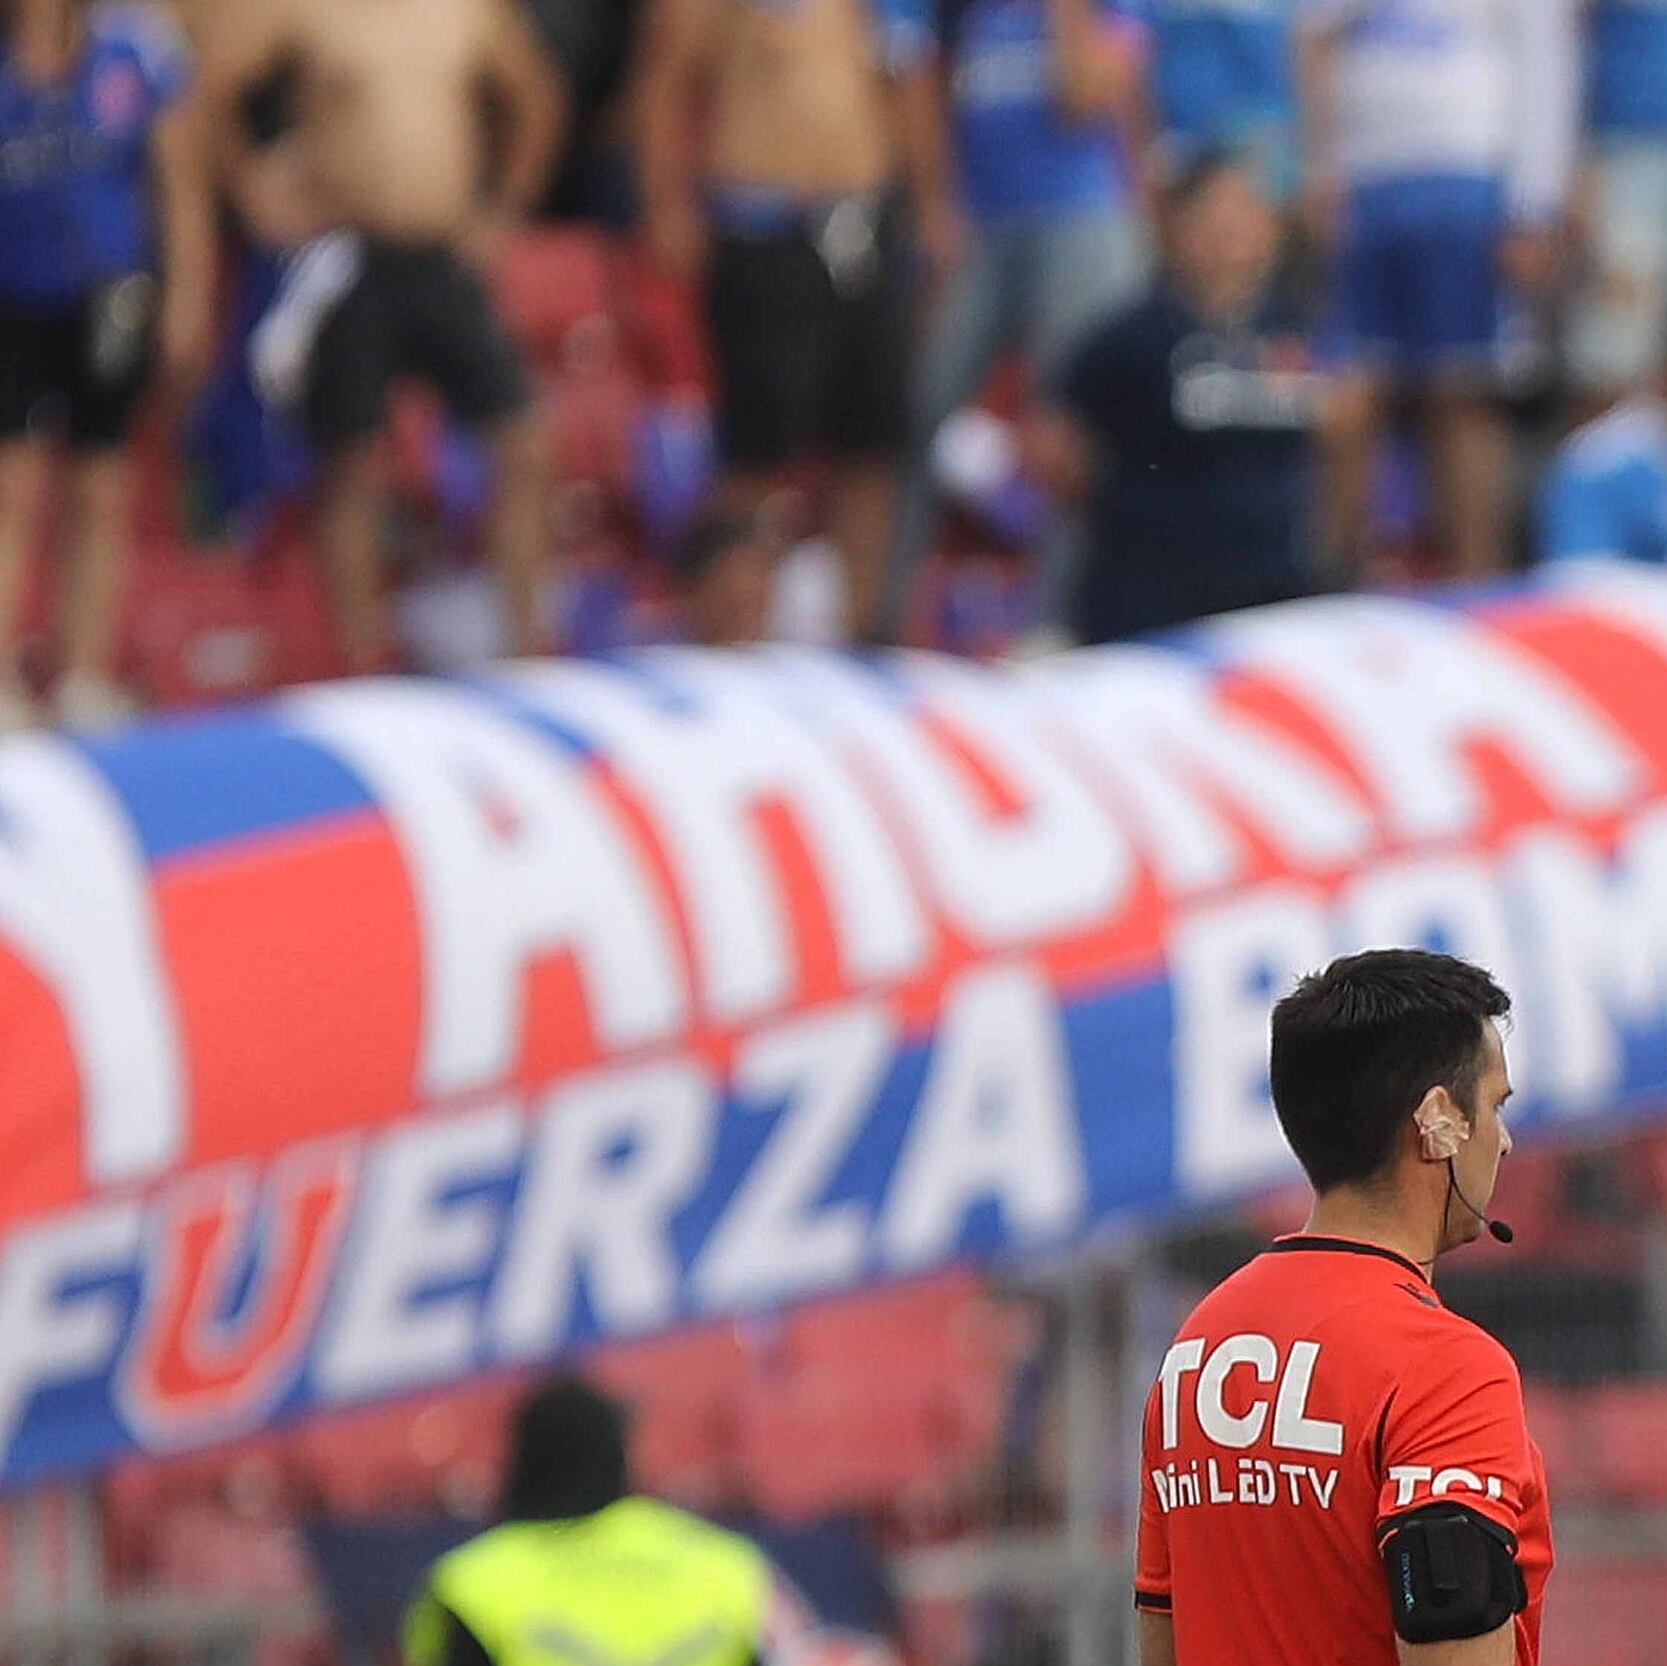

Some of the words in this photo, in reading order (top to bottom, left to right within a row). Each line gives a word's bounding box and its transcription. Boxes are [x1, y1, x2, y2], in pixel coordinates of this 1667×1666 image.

[0, 960, 1088, 1465] FUERZA
[1158, 1333, 1344, 1455] TCL
[1280, 1463, 1338, 1509] TV
